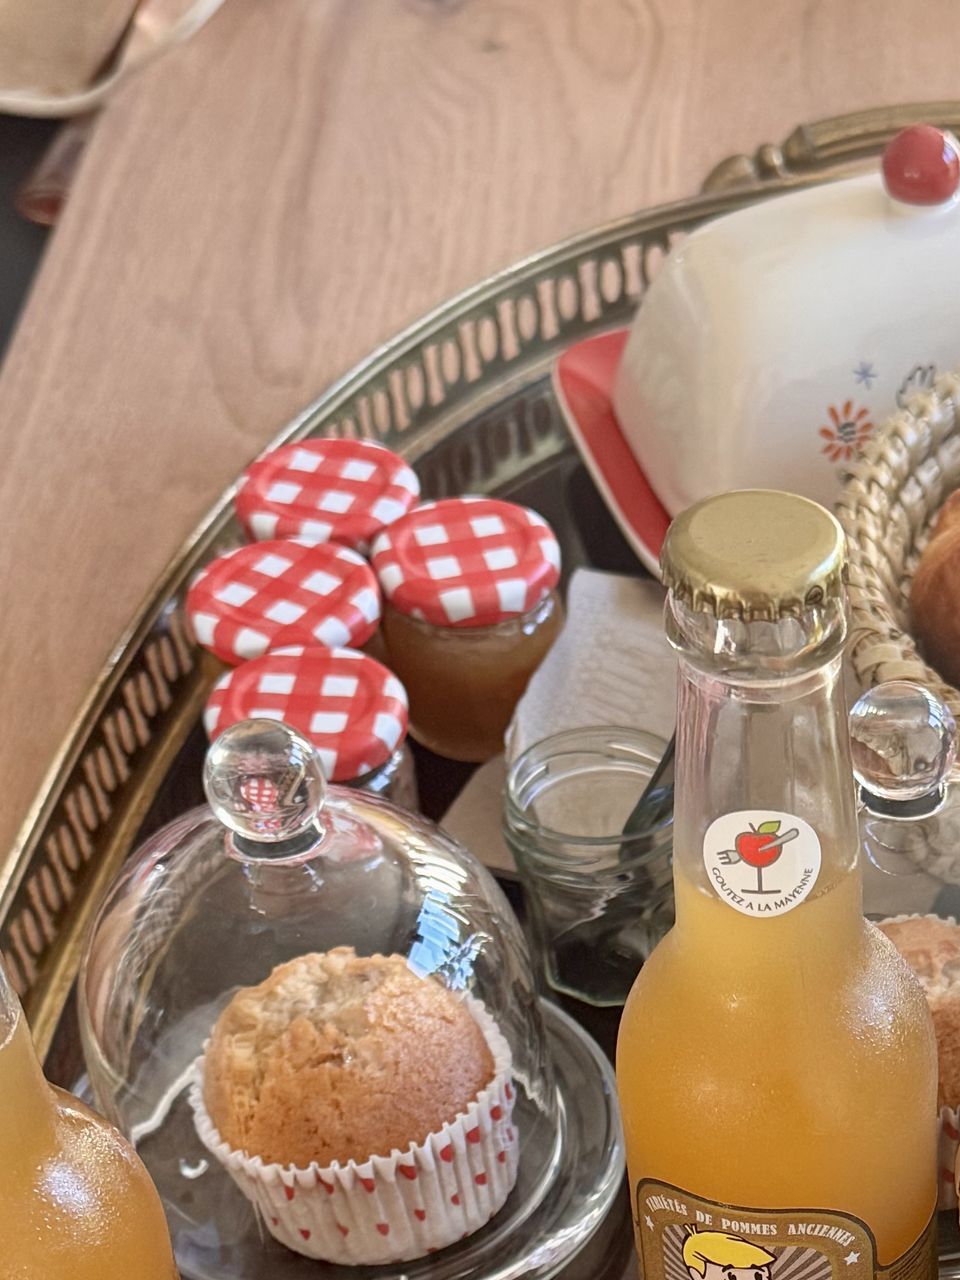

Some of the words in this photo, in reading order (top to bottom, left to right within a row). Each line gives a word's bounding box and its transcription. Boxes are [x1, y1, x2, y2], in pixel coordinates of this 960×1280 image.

[711, 867, 745, 906] GOUTEZ
[745, 901, 754, 911] A
[757, 901, 772, 912] LA
[774, 867, 814, 910] MAYENNE
[695, 1210, 713, 1227] DE
[720, 1218, 778, 1236] POMMES
[787, 1222, 856, 1248] ANCIENNES
